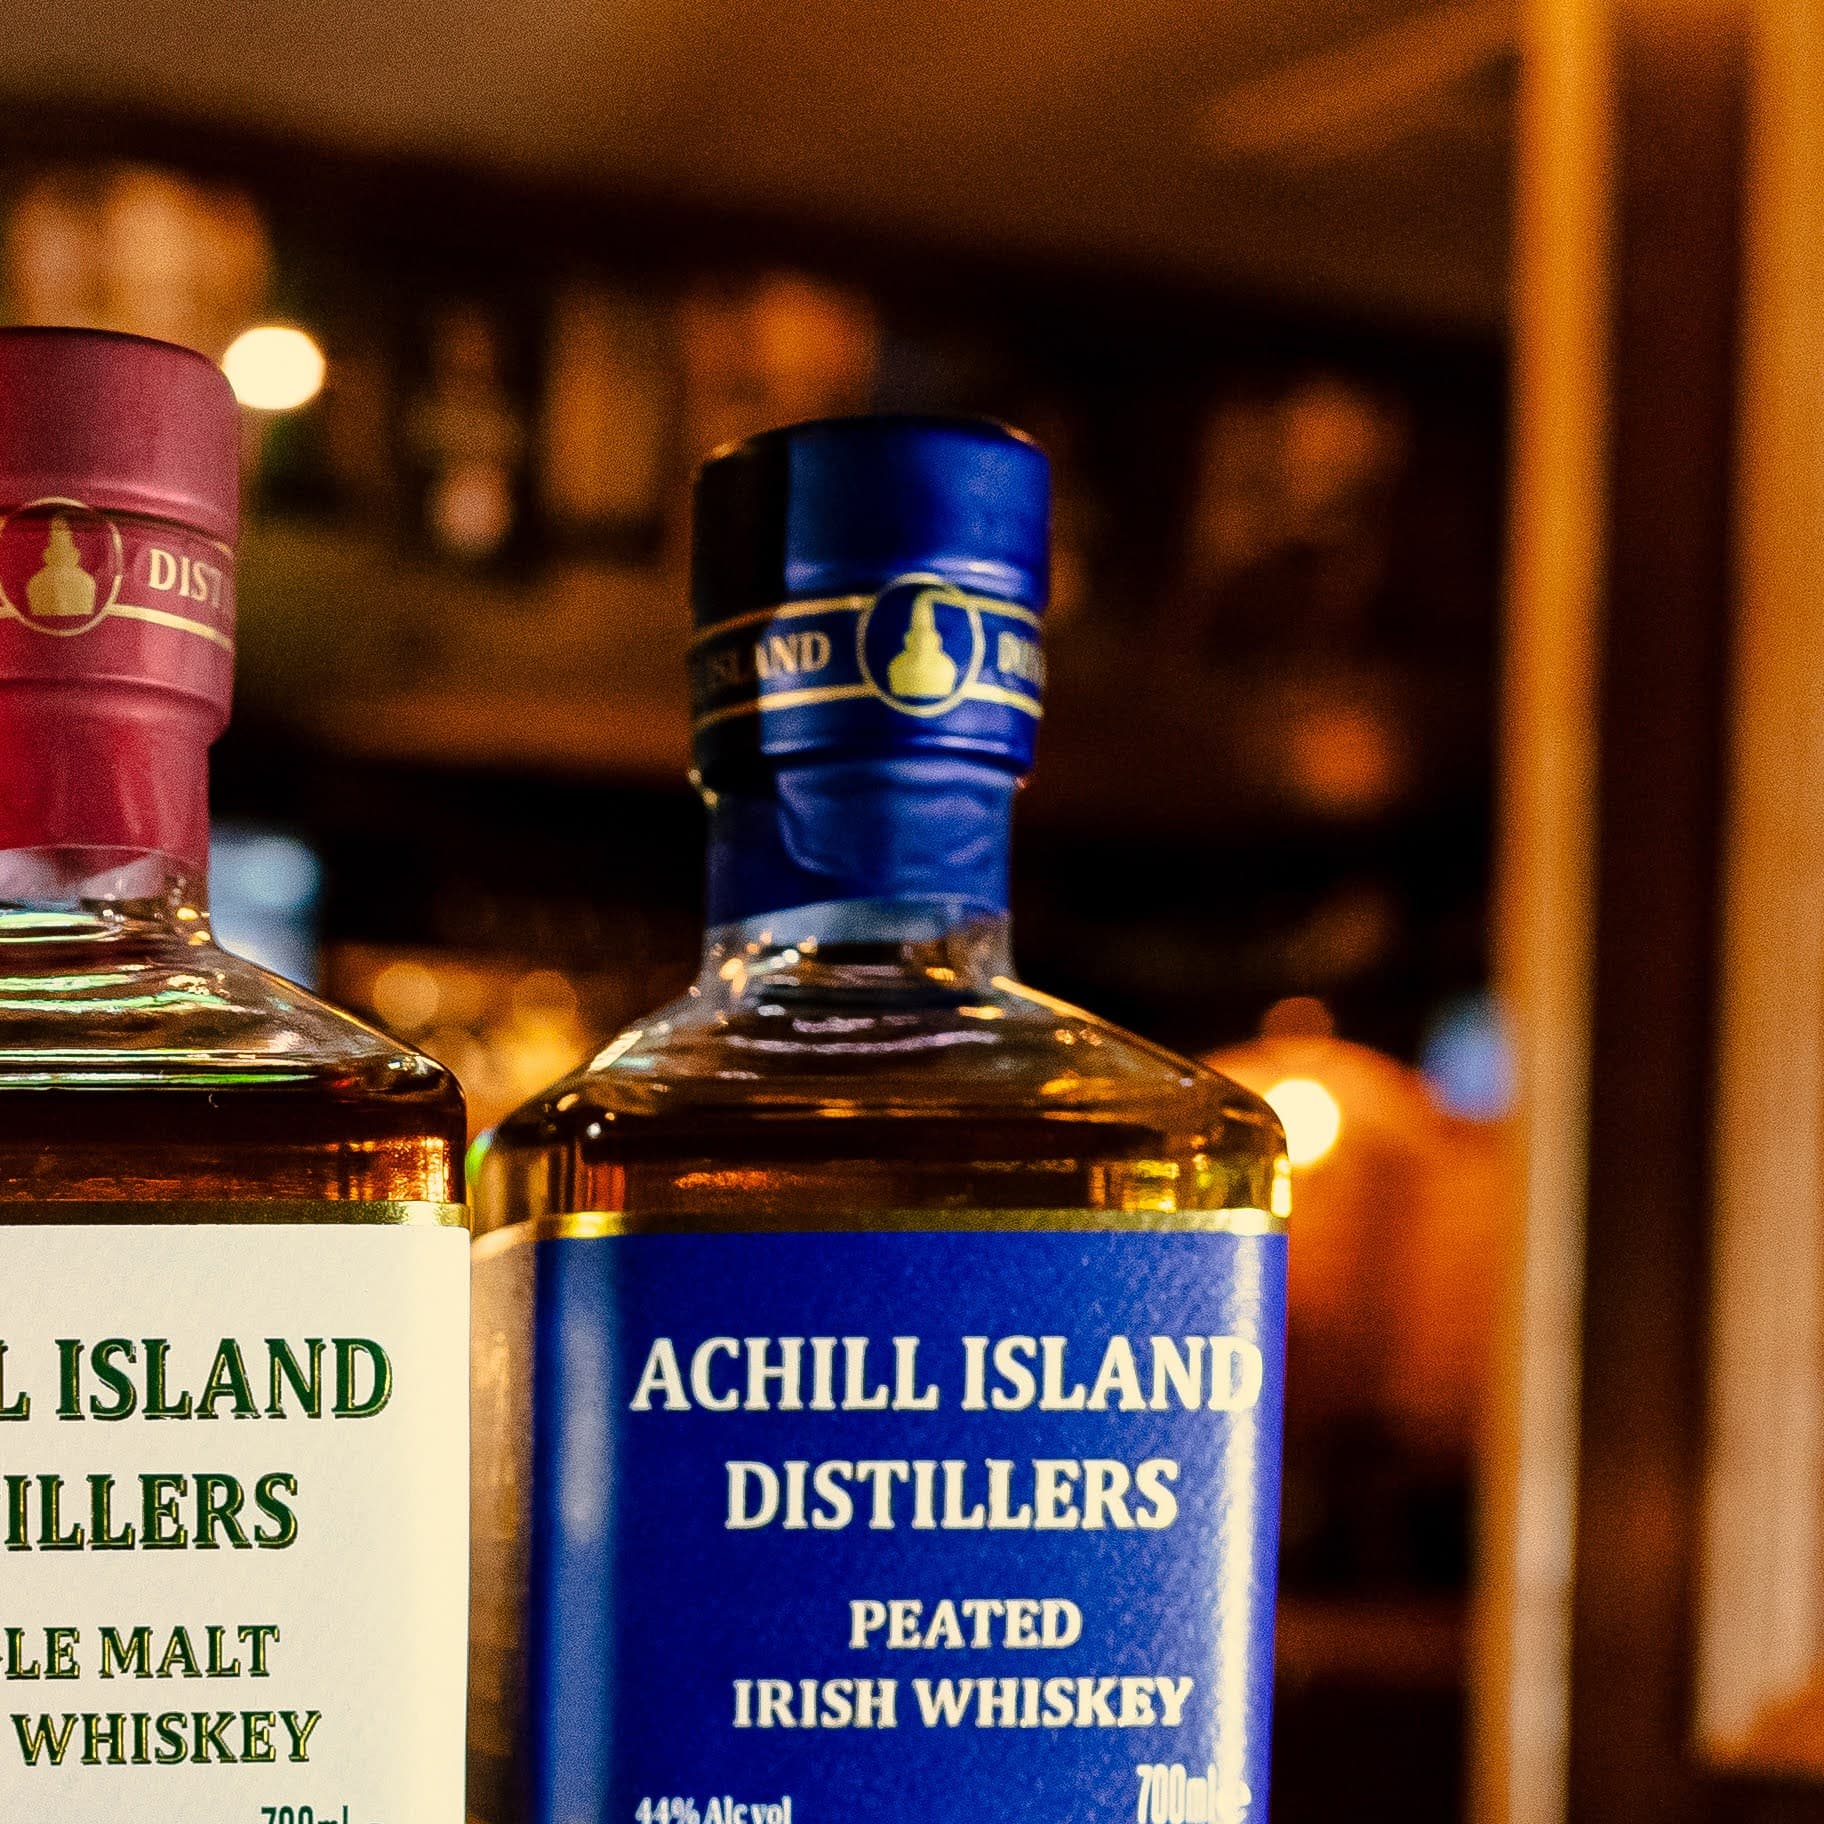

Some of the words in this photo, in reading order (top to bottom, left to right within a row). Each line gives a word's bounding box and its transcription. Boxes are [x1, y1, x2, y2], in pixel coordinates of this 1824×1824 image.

[54, 1336, 393, 1421] ISLAND
[629, 1336, 939, 1413] ACHILL
[961, 1336, 1265, 1413] ISLAND
[725, 1459, 1178, 1530] DISTILLERS
[98, 1624, 280, 1679] MALT
[849, 1599, 1083, 1649] PEATED
[732, 1679, 897, 1729] IRISH
[914, 1676, 1194, 1729] WHISKEY
[12, 1710, 322, 1767] WHISKEY
